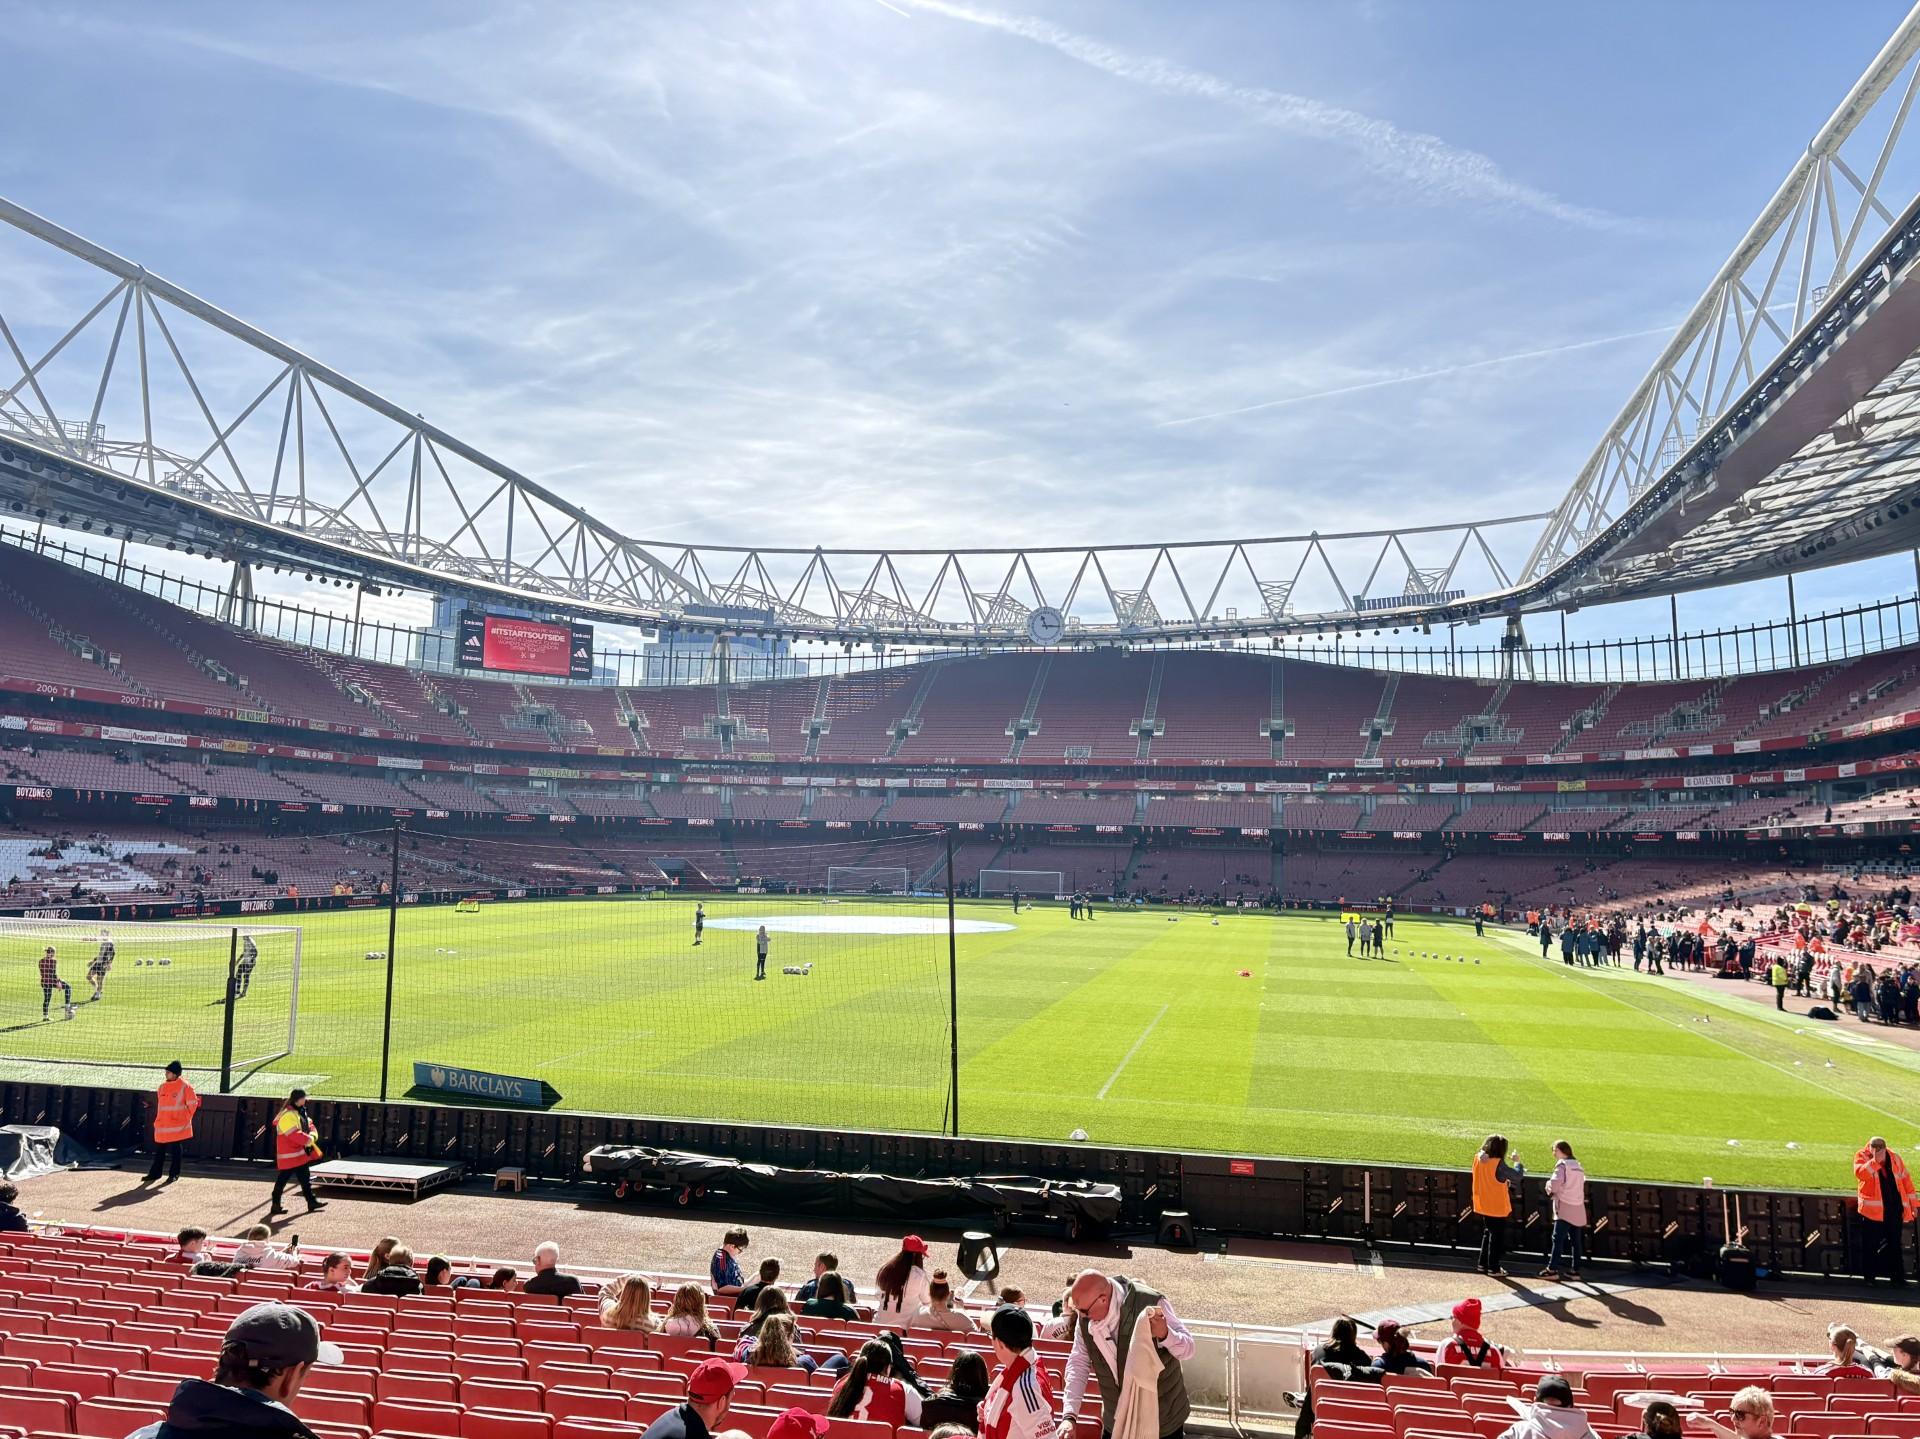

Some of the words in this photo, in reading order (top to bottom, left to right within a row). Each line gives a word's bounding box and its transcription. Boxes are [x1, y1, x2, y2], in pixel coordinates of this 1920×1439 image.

[491, 627, 565, 642] #ITSTARTSOUTSIDE
[36, 684, 58, 694] 2006
[121, 695, 140, 705] 2007
[200, 738, 223, 750] Arsenal
[449, 763, 472, 772] Arsenal
[537, 768, 578, 778] AUSTRALIA
[1693, 774, 1725, 785] DAVENTRY
[1749, 773, 1774, 784] Arsenal
[16, 786, 45, 798] BOYZONE
[1194, 783, 1218, 791] Arsenal
[1496, 783, 1521, 793] Arsenal
[190, 796, 212, 807] BOYZONE
[1393, 831, 1416, 839] BOYZONE
[1543, 832, 1565, 840] BOYZONE
[241, 900, 268, 912] BOYZONE
[24, 909, 61, 919] BOYZONE
[449, 1070, 523, 1098] BARCLAYS
